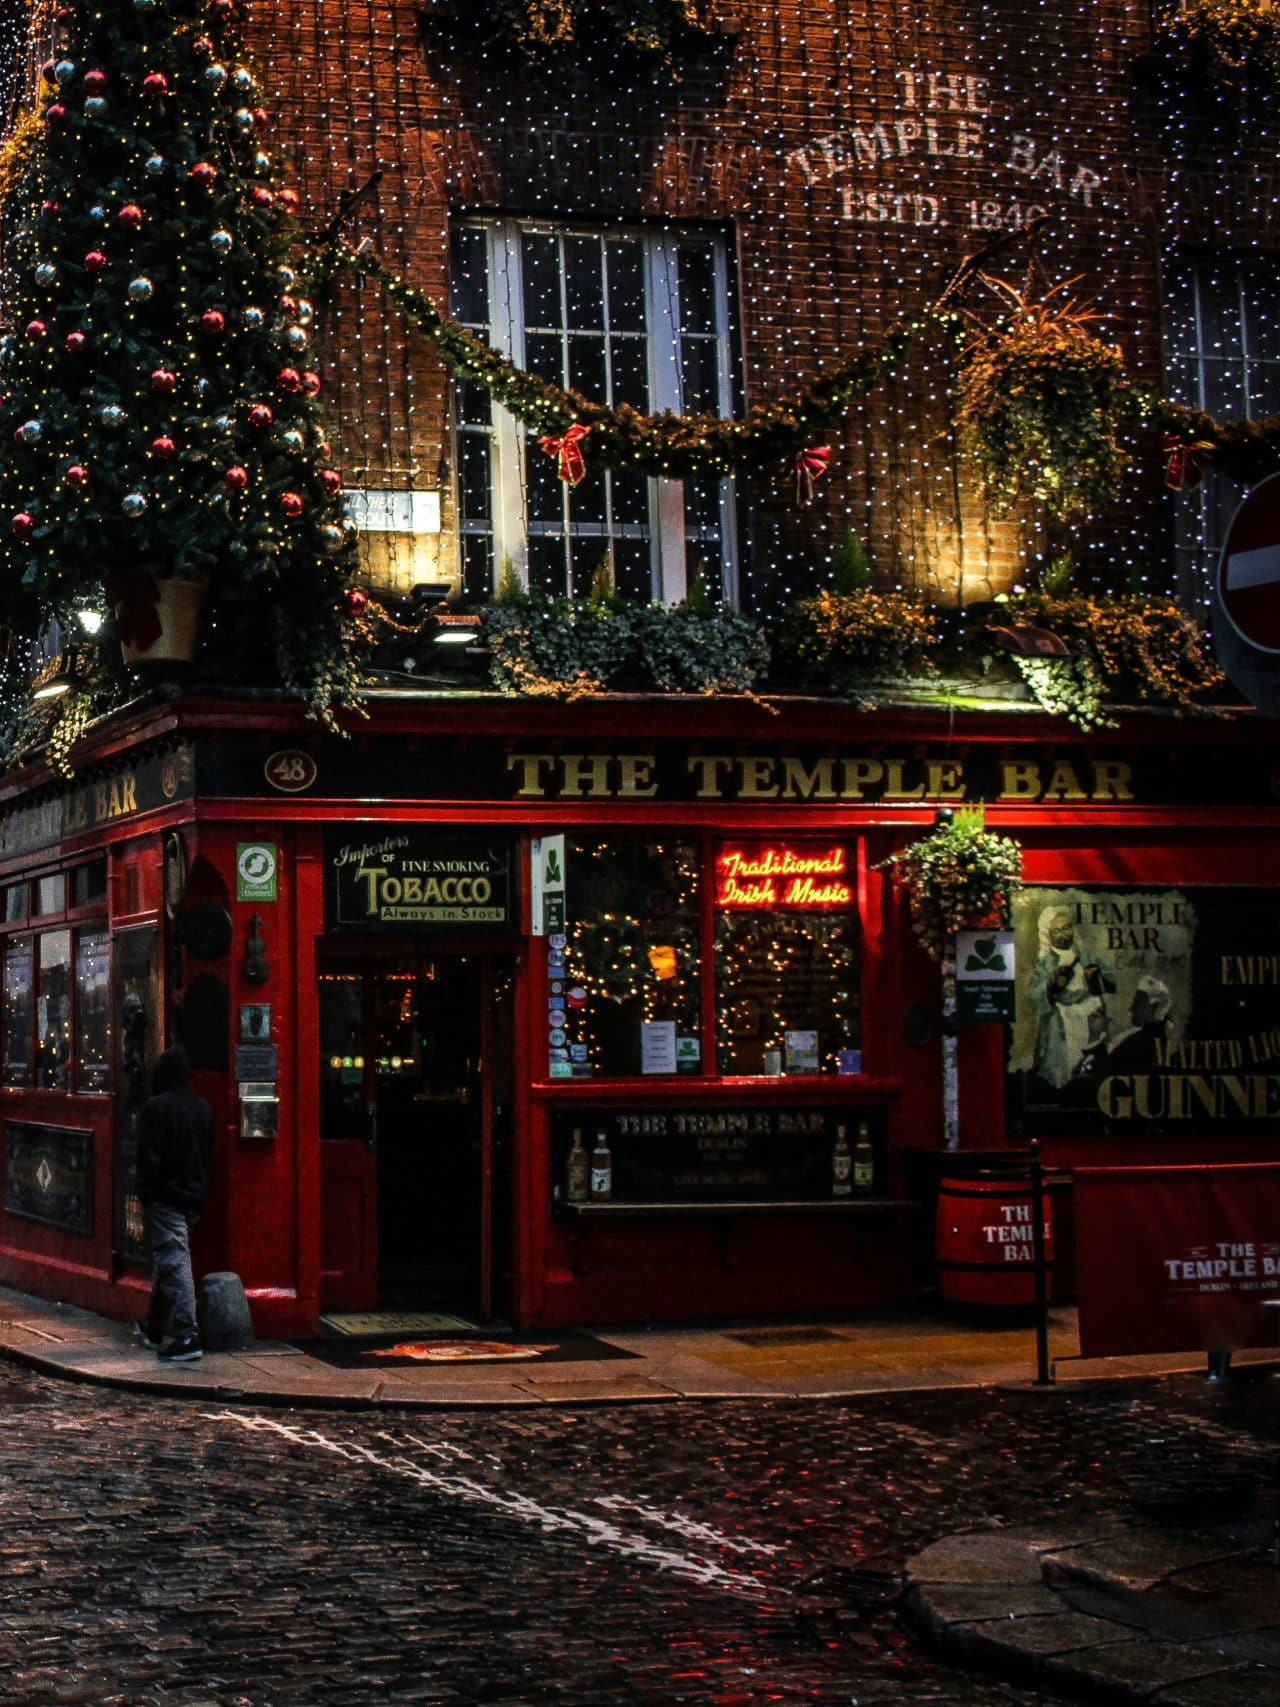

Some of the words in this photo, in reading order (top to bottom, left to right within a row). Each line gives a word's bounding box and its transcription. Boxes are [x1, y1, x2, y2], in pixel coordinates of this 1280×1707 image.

[894, 69, 990, 113] THE
[783, 117, 985, 186] TEMPLE
[1006, 134, 1103, 208] BAR
[275, 757, 306, 782] 48
[506, 754, 659, 798] THE
[687, 755, 968, 798] TEMPLE
[998, 760, 1136, 800] BAR
[95, 773, 138, 822] BAR
[332, 834, 410, 868] Importers
[381, 853, 396, 863] OF
[723, 848, 844, 877] Traditional
[401, 860, 431, 873] FINE
[432, 860, 491, 873] SMOKING
[353, 866, 492, 915] TOBACCO
[719, 878, 776, 905] Irish
[785, 877, 851, 903] Music
[383, 908, 434, 920] Always
[442, 908, 456, 918] in
[462, 907, 503, 919] Stock
[1072, 902, 1193, 926] TEMPLE
[1107, 927, 1164, 953] BAR
[1152, 1036, 1244, 1071] MALTED
[616, 1112, 669, 1136] THE
[670, 1112, 771, 1137] TEMPLE
[777, 1112, 825, 1134] BAR
[1001, 1204, 1030, 1222] TH
[1004, 1244, 1034, 1262] BA
[1216, 1241, 1256, 1258] THE
[1164, 1258, 1258, 1281] TEMPLE
